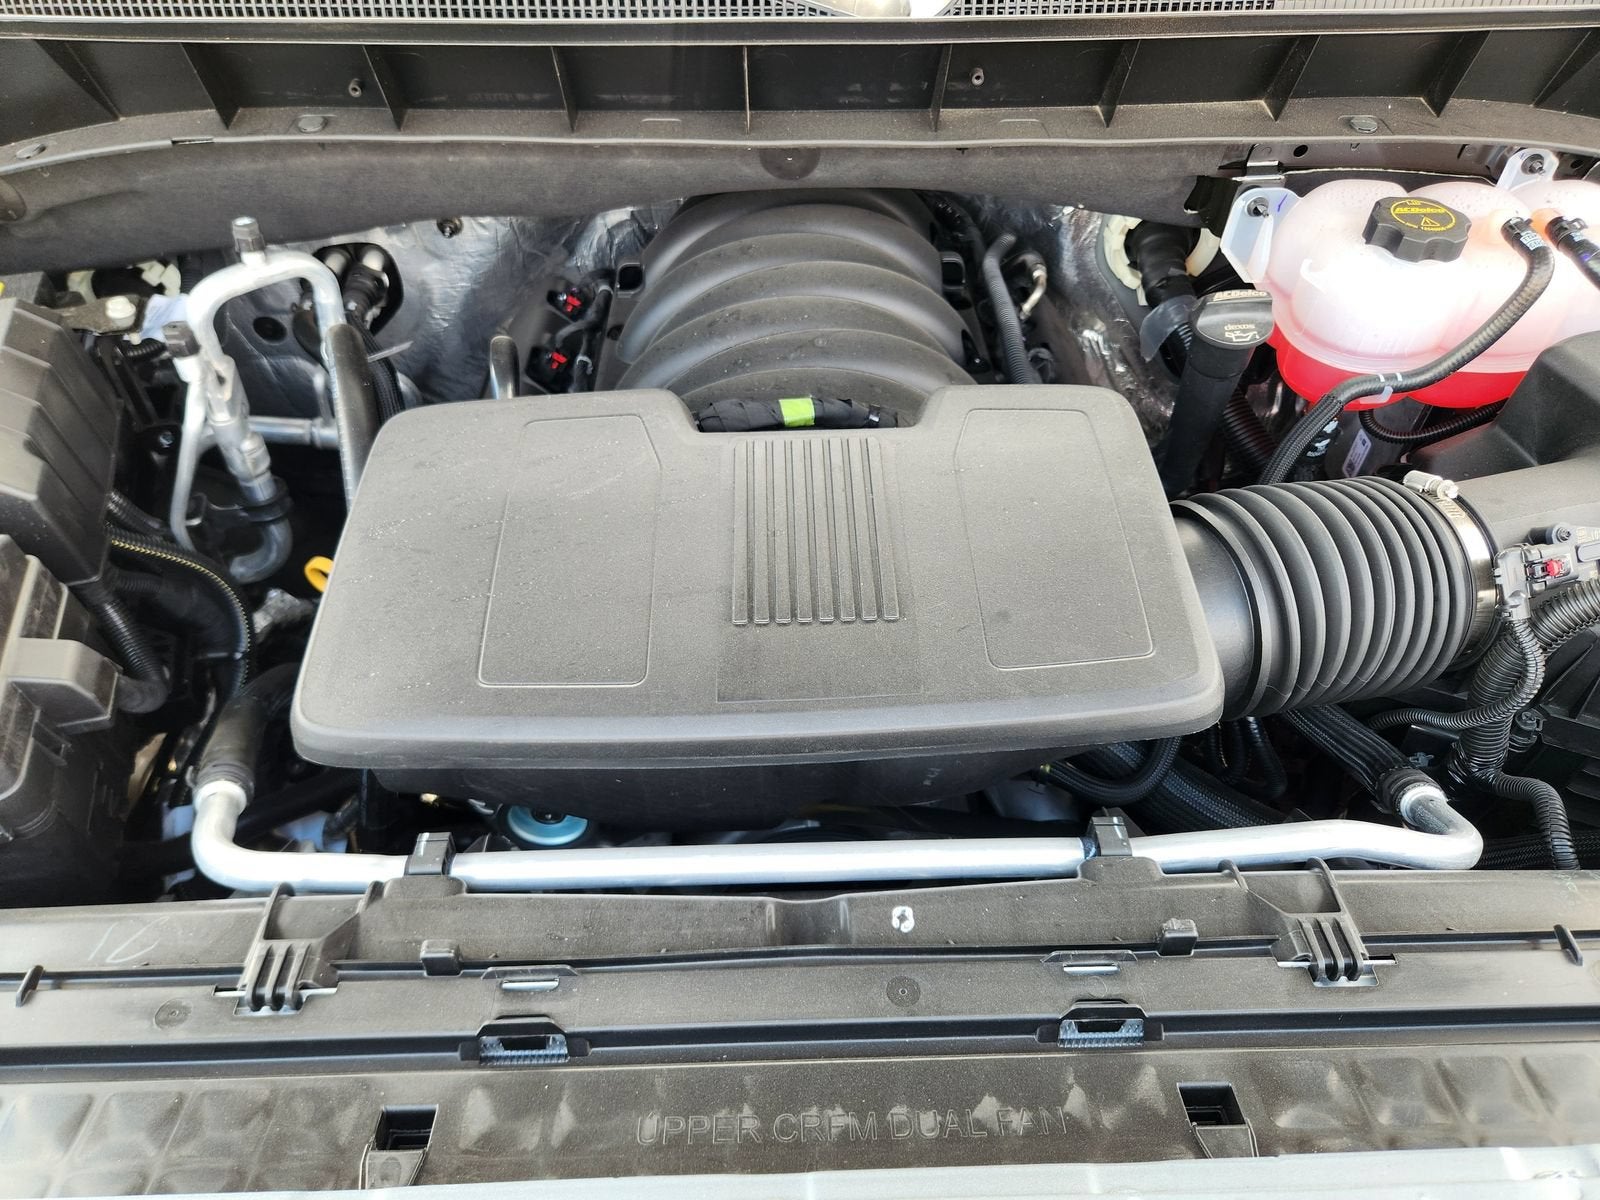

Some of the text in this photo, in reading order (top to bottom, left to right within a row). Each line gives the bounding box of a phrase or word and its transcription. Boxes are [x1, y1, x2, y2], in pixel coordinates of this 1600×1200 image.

[1213, 290, 1268, 301] ACDelco
[636, 1105, 1068, 1146] UPPER CRFM DUAL FAN
